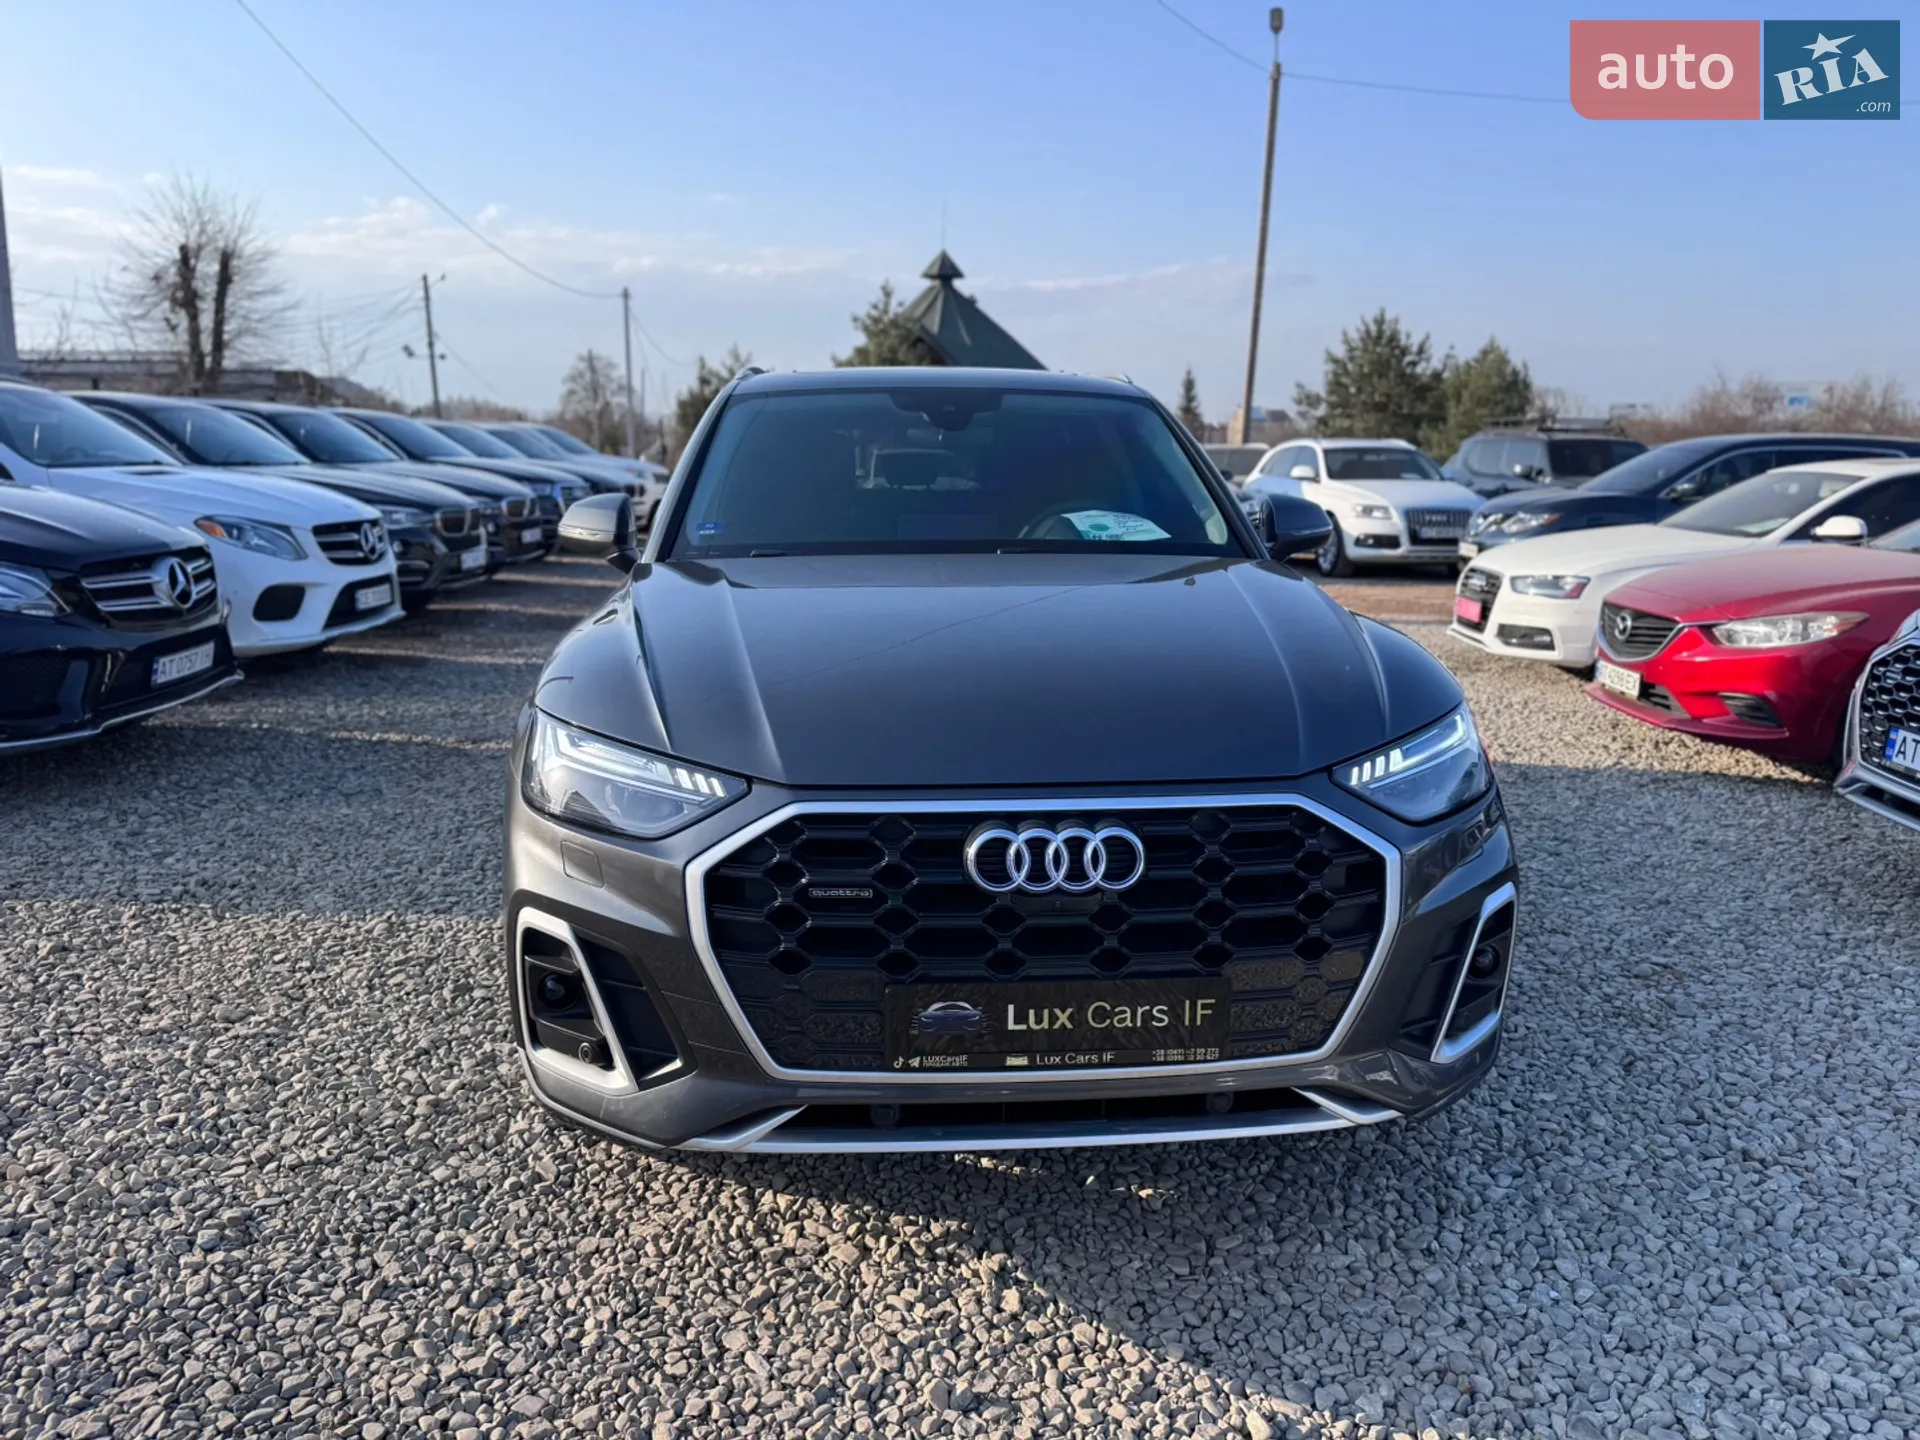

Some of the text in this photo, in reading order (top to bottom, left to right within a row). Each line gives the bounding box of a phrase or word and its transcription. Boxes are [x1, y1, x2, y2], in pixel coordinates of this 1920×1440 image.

[158, 658, 175, 678] AT
[1895, 735, 1920, 764] AT
[1007, 999, 1215, 1031] Lux Cars IF
[1036, 1052, 1116, 1065] Lux Cars IF
